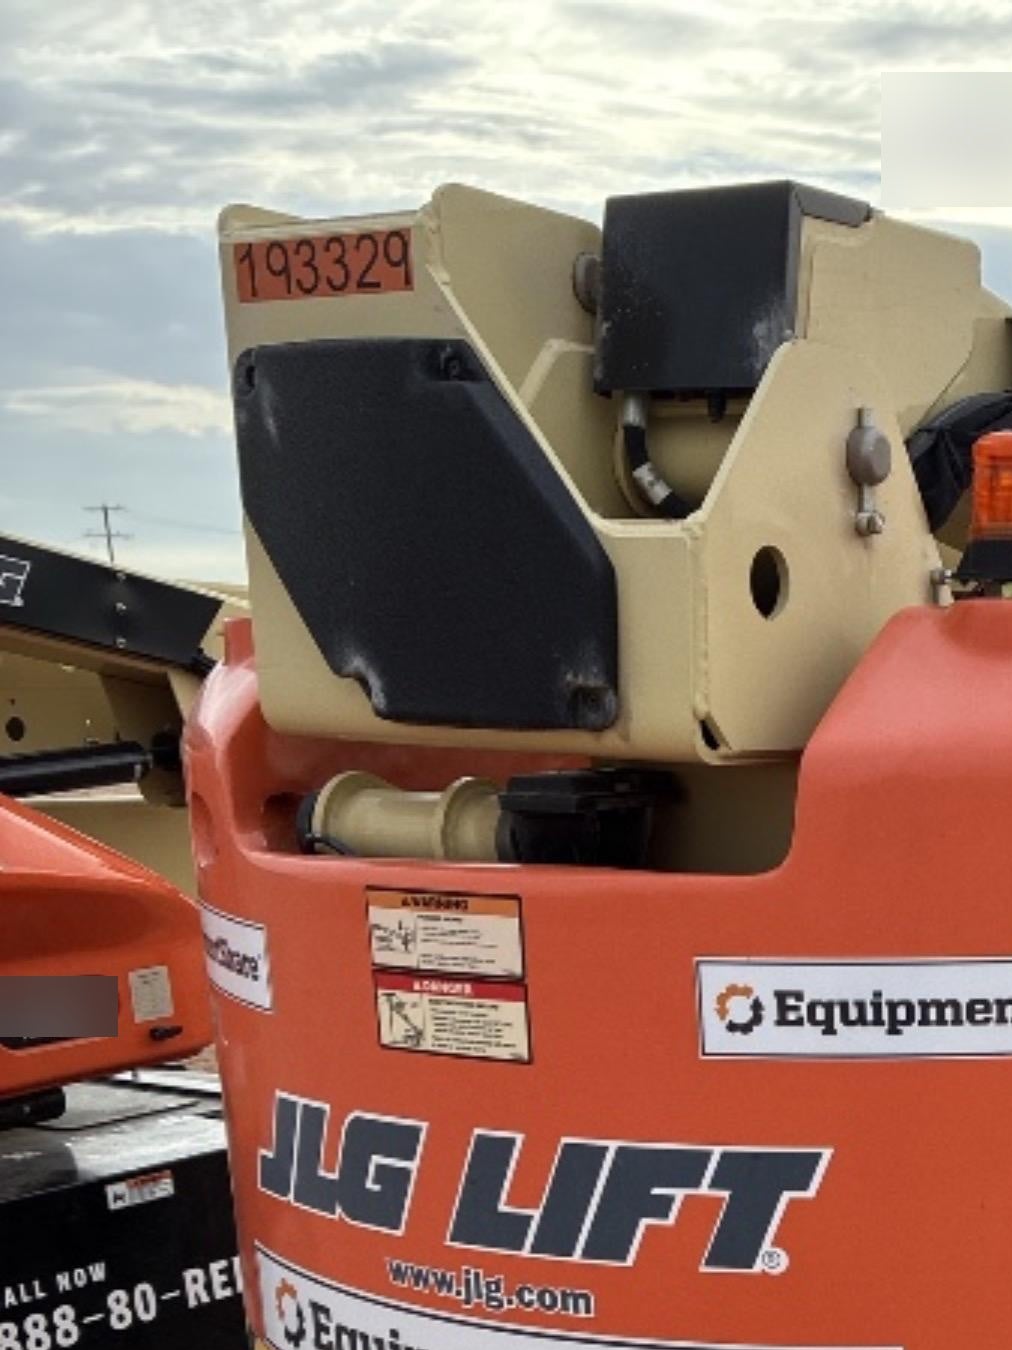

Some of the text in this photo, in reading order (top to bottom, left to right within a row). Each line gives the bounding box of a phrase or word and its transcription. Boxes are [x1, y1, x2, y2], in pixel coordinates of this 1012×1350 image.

[239, 230, 411, 297] 193329
[257, 1090, 429, 1236] JLG
[55, 1261, 107, 1293] NOW
[386, 1256, 595, 1319] www.jlg.com
